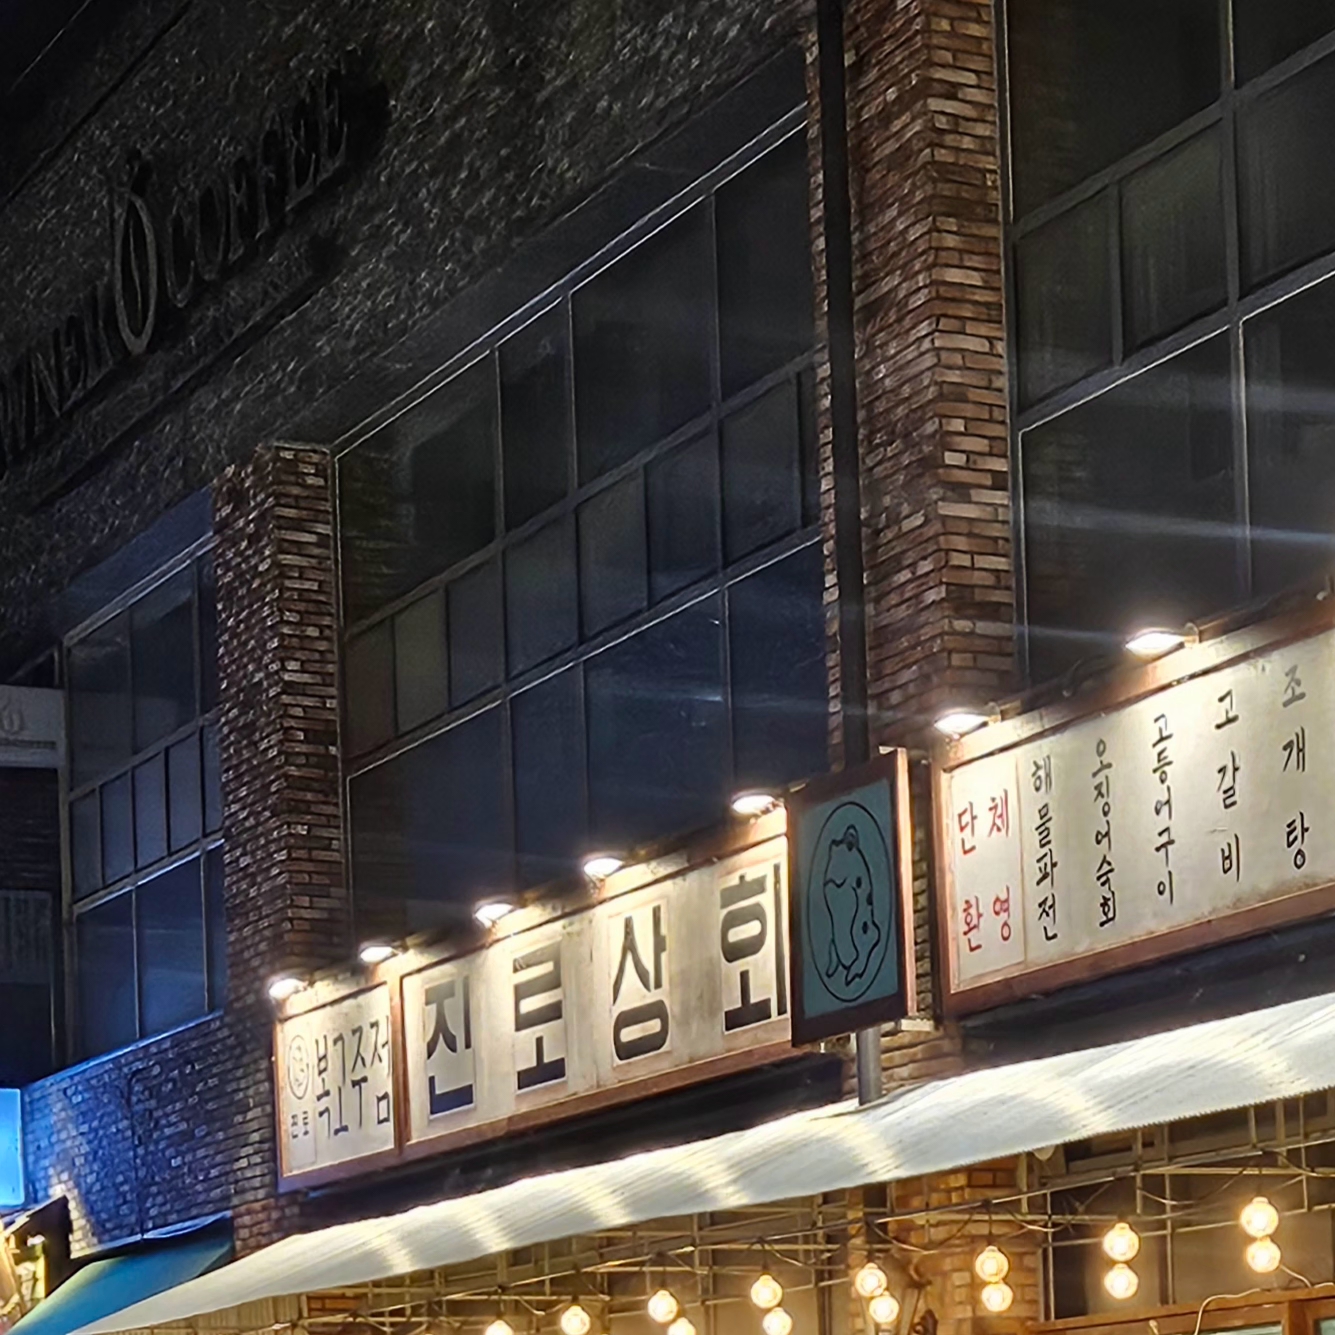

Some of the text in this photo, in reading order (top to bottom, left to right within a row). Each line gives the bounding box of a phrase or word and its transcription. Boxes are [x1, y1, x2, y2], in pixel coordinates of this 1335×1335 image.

[957, 788, 1010, 856] 단체
[1030, 754, 1058, 942] 해물파전
[1091, 738, 1117, 928] 오징어숙회
[1151, 713, 1174, 906] 고등어구이
[1214, 689, 1241, 882] 고갈비
[1281, 664, 1309, 870] 조개탕
[424, 860, 789, 1117] 진로상회
[961, 886, 1012, 953] 환영
[315, 1015, 391, 1140] 복고주점
